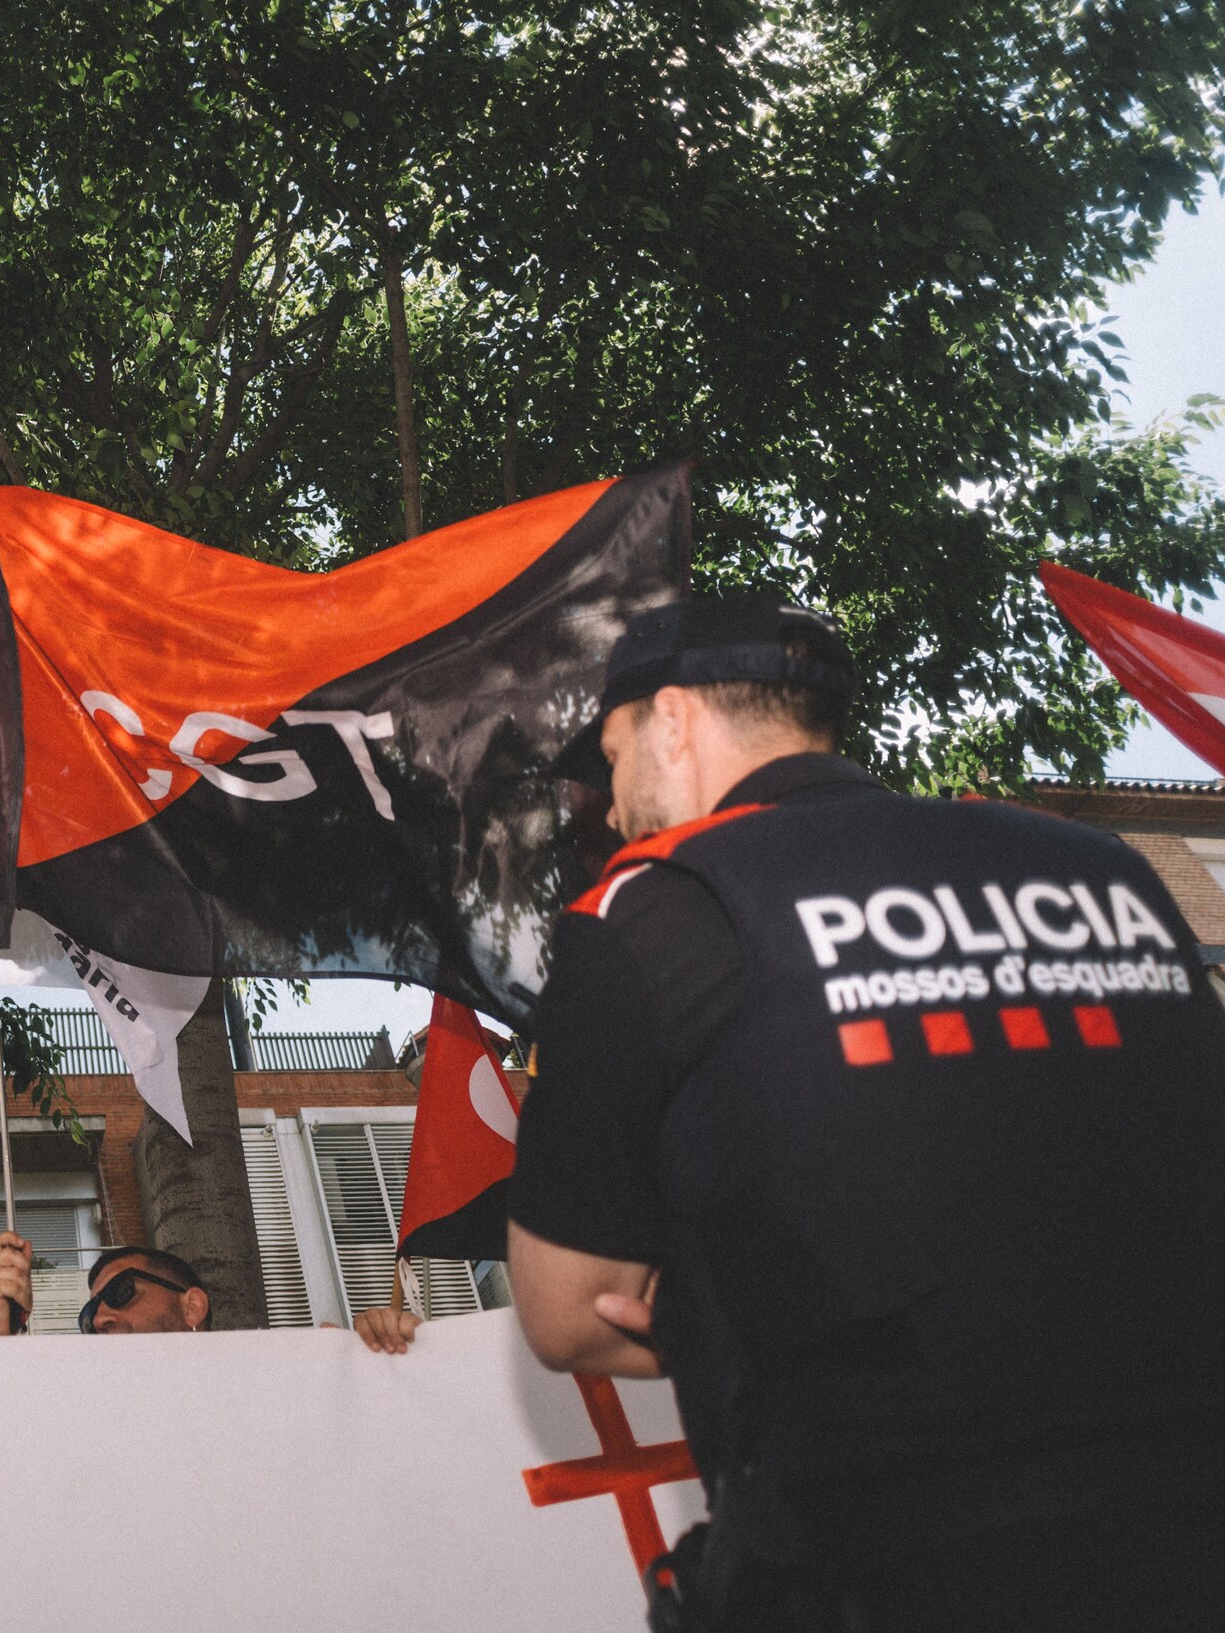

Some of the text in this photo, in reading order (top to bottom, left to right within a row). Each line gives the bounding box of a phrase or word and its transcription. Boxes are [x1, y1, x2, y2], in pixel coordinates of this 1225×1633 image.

[79, 690, 395, 821] CGT
[794, 881, 1177, 968] POLICIA
[824, 953, 1191, 1014] mossos d'esquadra
